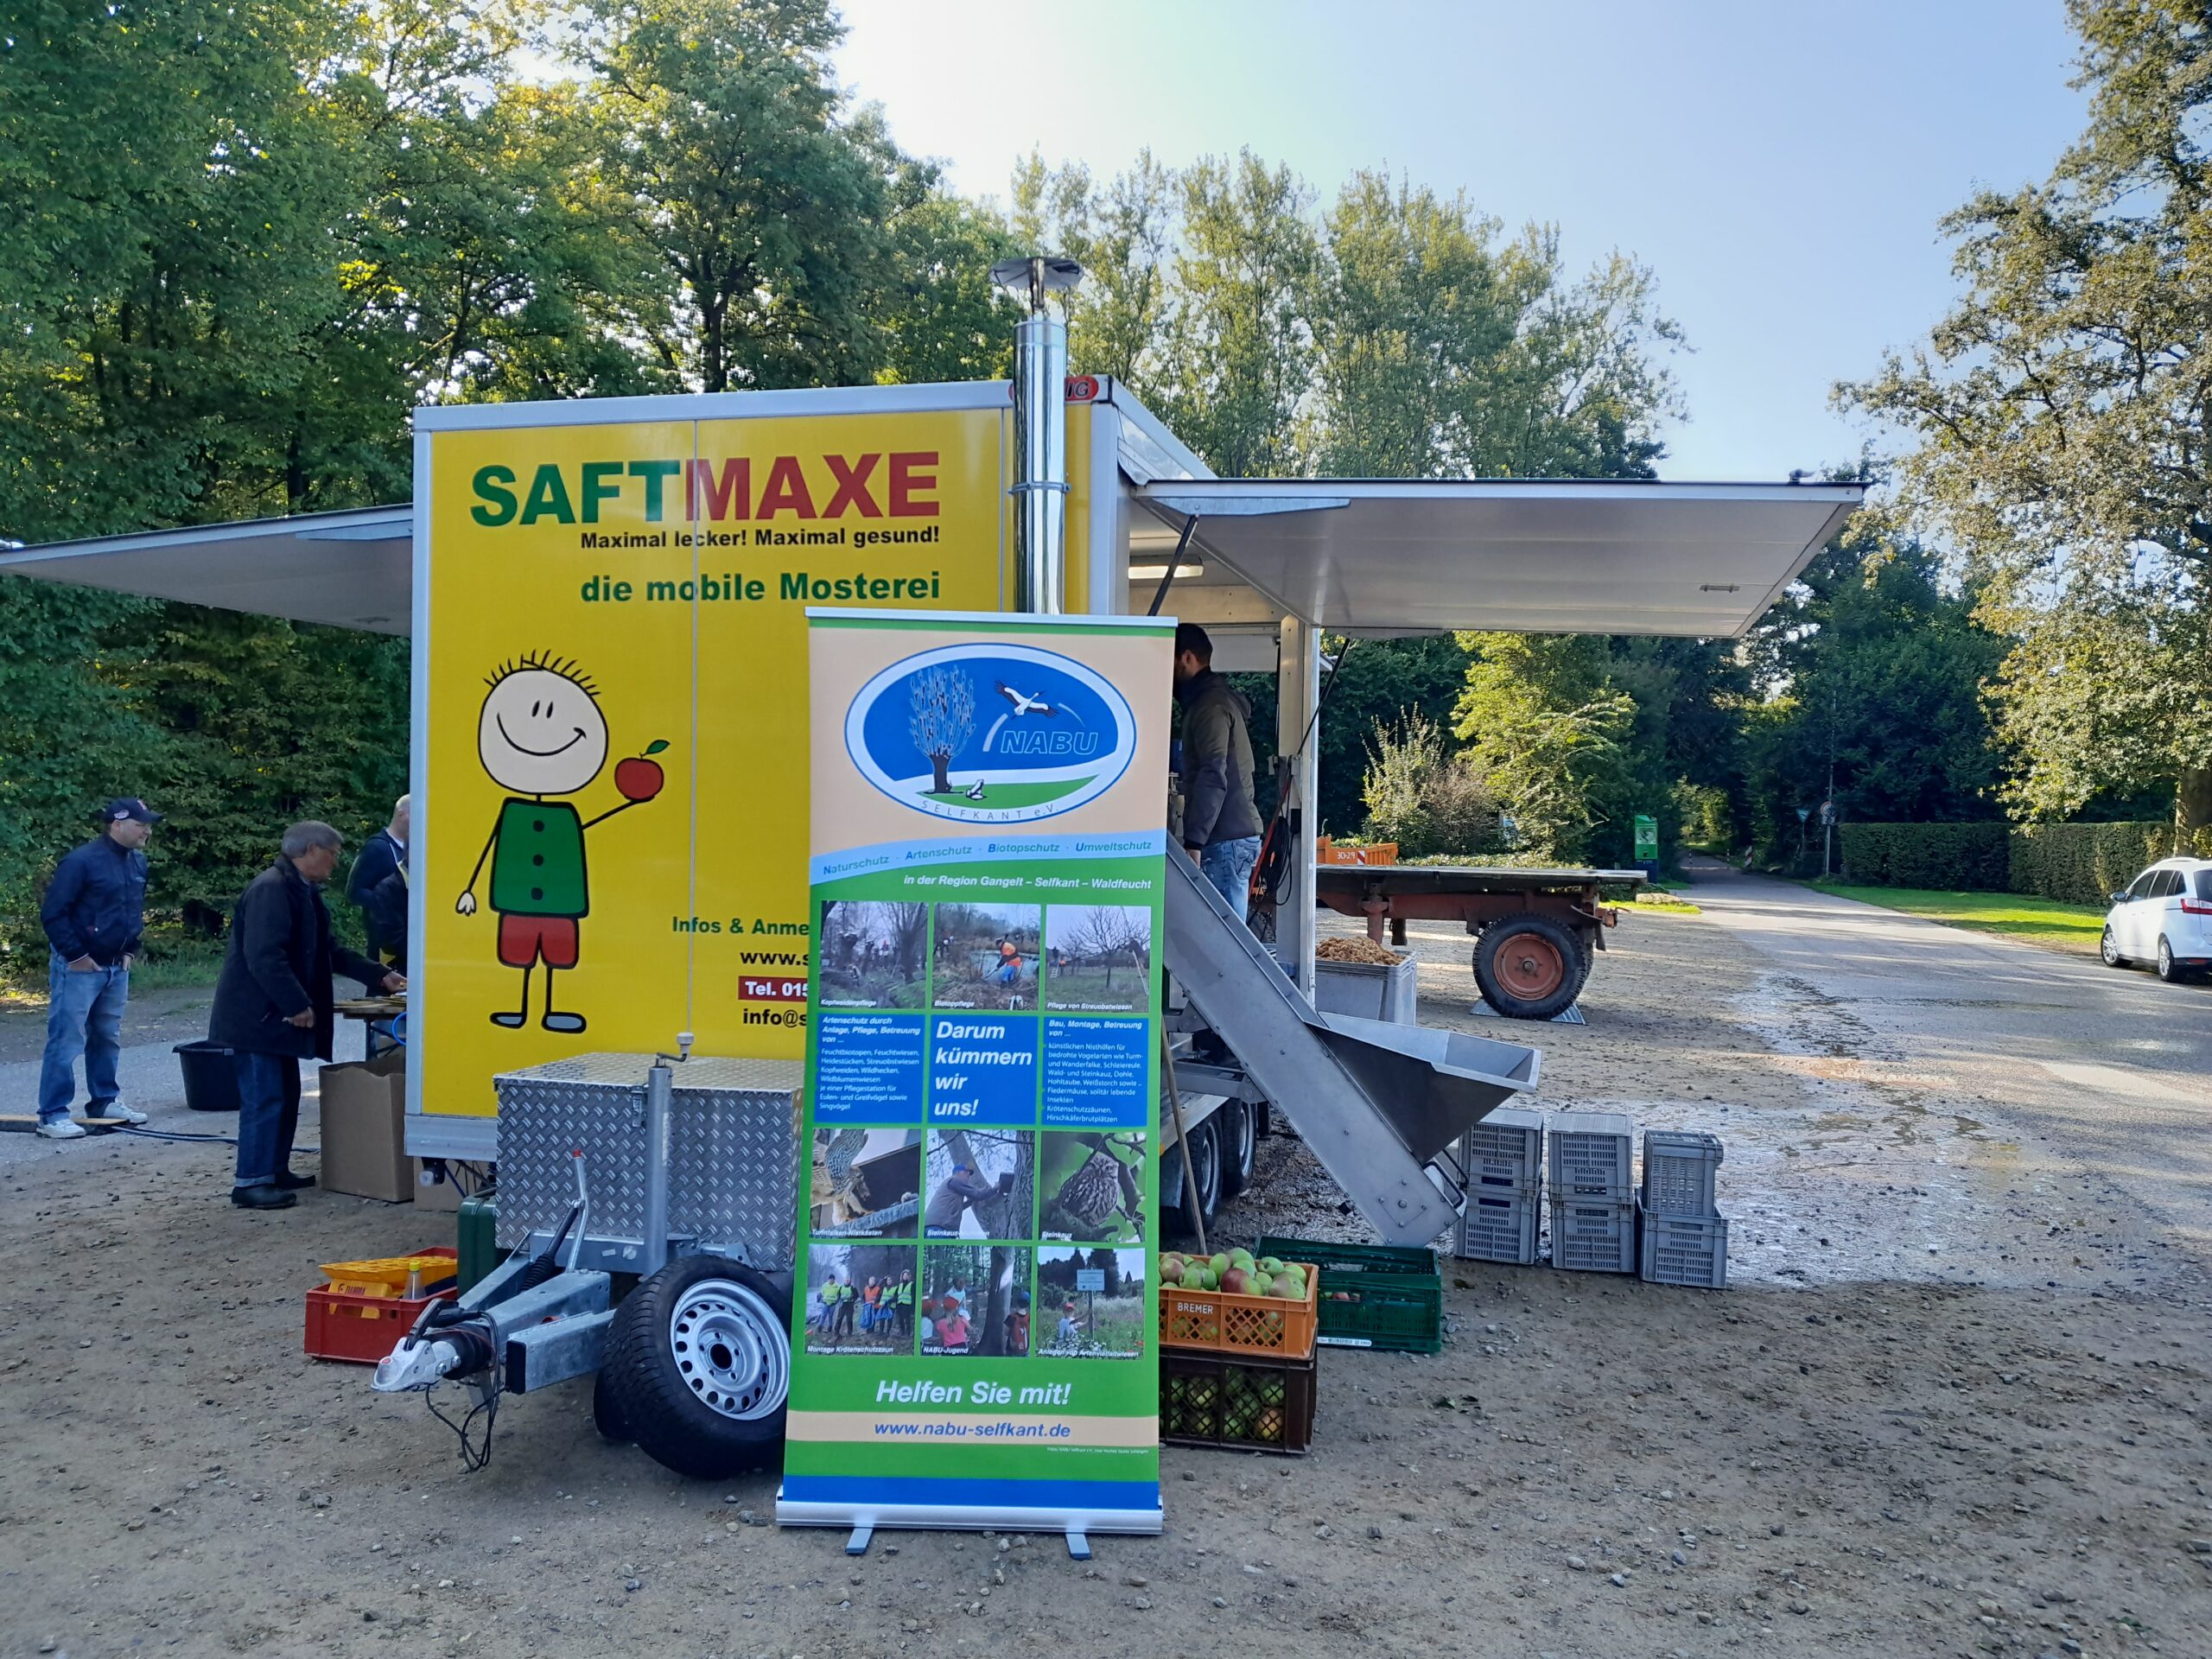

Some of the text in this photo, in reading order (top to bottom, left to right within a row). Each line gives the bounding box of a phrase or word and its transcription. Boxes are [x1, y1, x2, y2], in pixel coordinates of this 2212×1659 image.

[470, 451, 940, 526] SAFTMAXE
[581, 526, 940, 550] Maximal lecker! Maximal gesund!
[581, 571, 940, 603] die mobile Mosterei
[1001, 730, 1098, 754] NABU
[922, 800, 1058, 820] SELFKANT e.V.
[823, 841, 1152, 874] Naturschutz Artenschutz Biotopschutz Umweltschutz
[904, 875, 915, 886] in
[917, 875, 937, 886] der
[938, 875, 977, 888] Region
[980, 876, 1023, 888] Gangelt
[1035, 876, 1079, 887] Selfkant
[1091, 877, 1152, 889] Waldfeucht
[673, 917, 721, 933] Infos
[730, 918, 743, 933] &
[746, 982, 776, 995] Tel.
[823, 1027, 920, 1035] Anlage, Pflege, Betreuung
[937, 1021, 1005, 1039] Darum
[1068, 1020, 1102, 1029] Montage,
[1104, 1021, 1142, 1030] Betreuung
[936, 1047, 1032, 1065] kümmern
[936, 1073, 968, 1090] wir
[935, 1099, 979, 1116] uns!
[1178, 1302, 1214, 1314] BREMER
[876, 1380, 1071, 1406] Helfen Sie mit!
[874, 1422, 1071, 1438] www.nabu-selfkant.de
